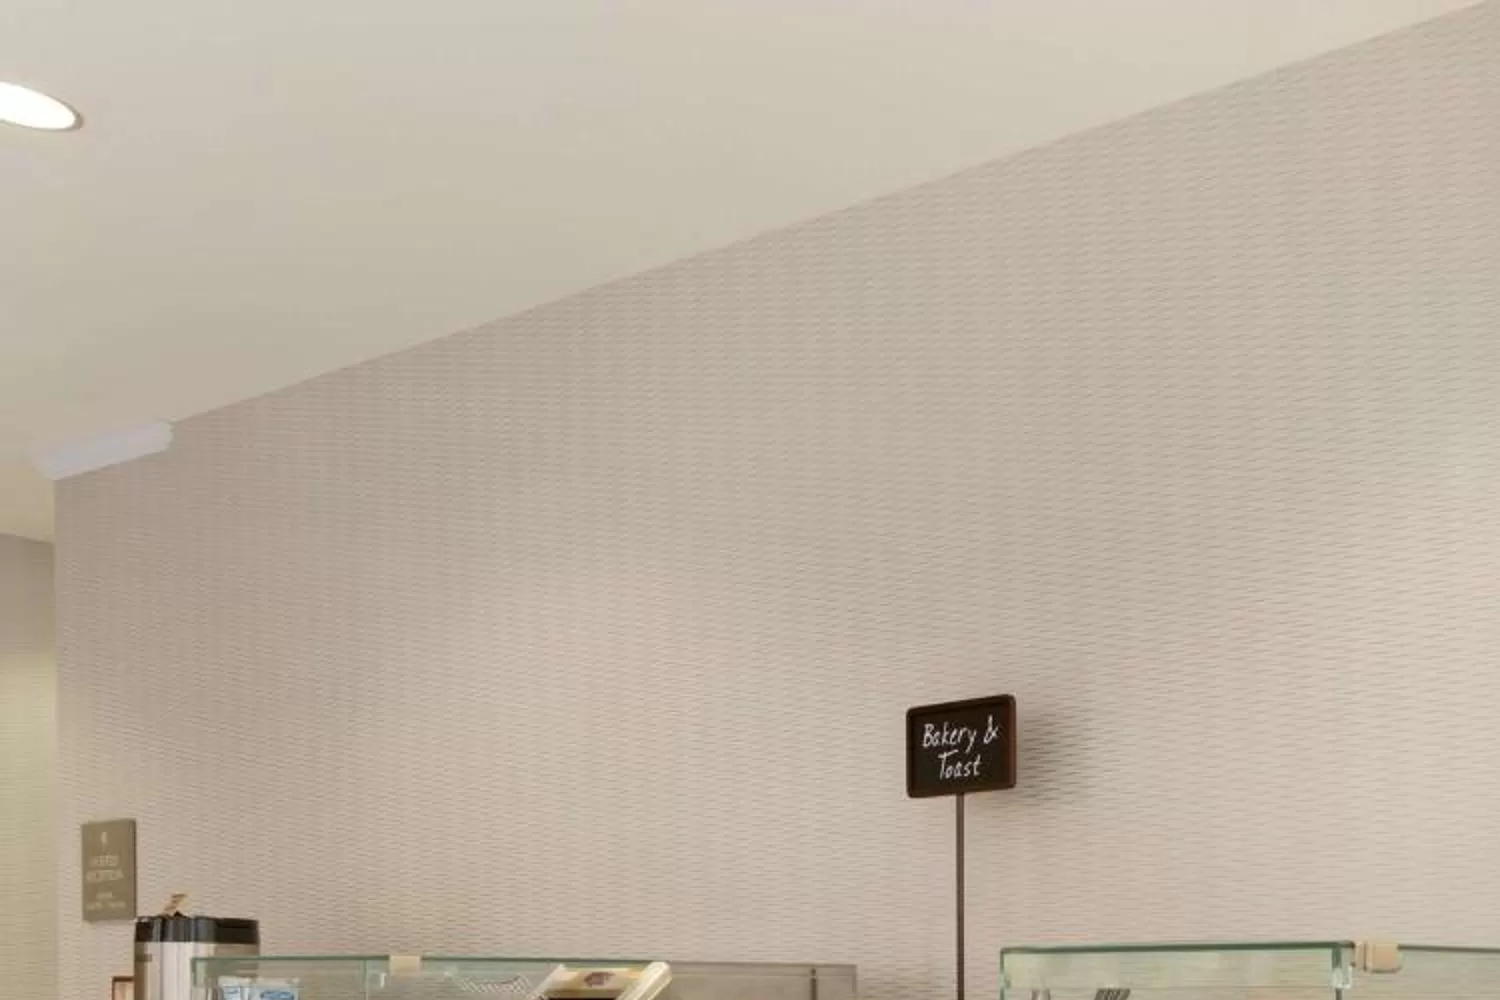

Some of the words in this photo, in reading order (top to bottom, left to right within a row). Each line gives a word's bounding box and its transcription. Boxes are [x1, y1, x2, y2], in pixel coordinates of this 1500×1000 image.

[922, 721, 977, 754] Bakery
[983, 714, 999, 744] &
[937, 749, 982, 780] Toast
